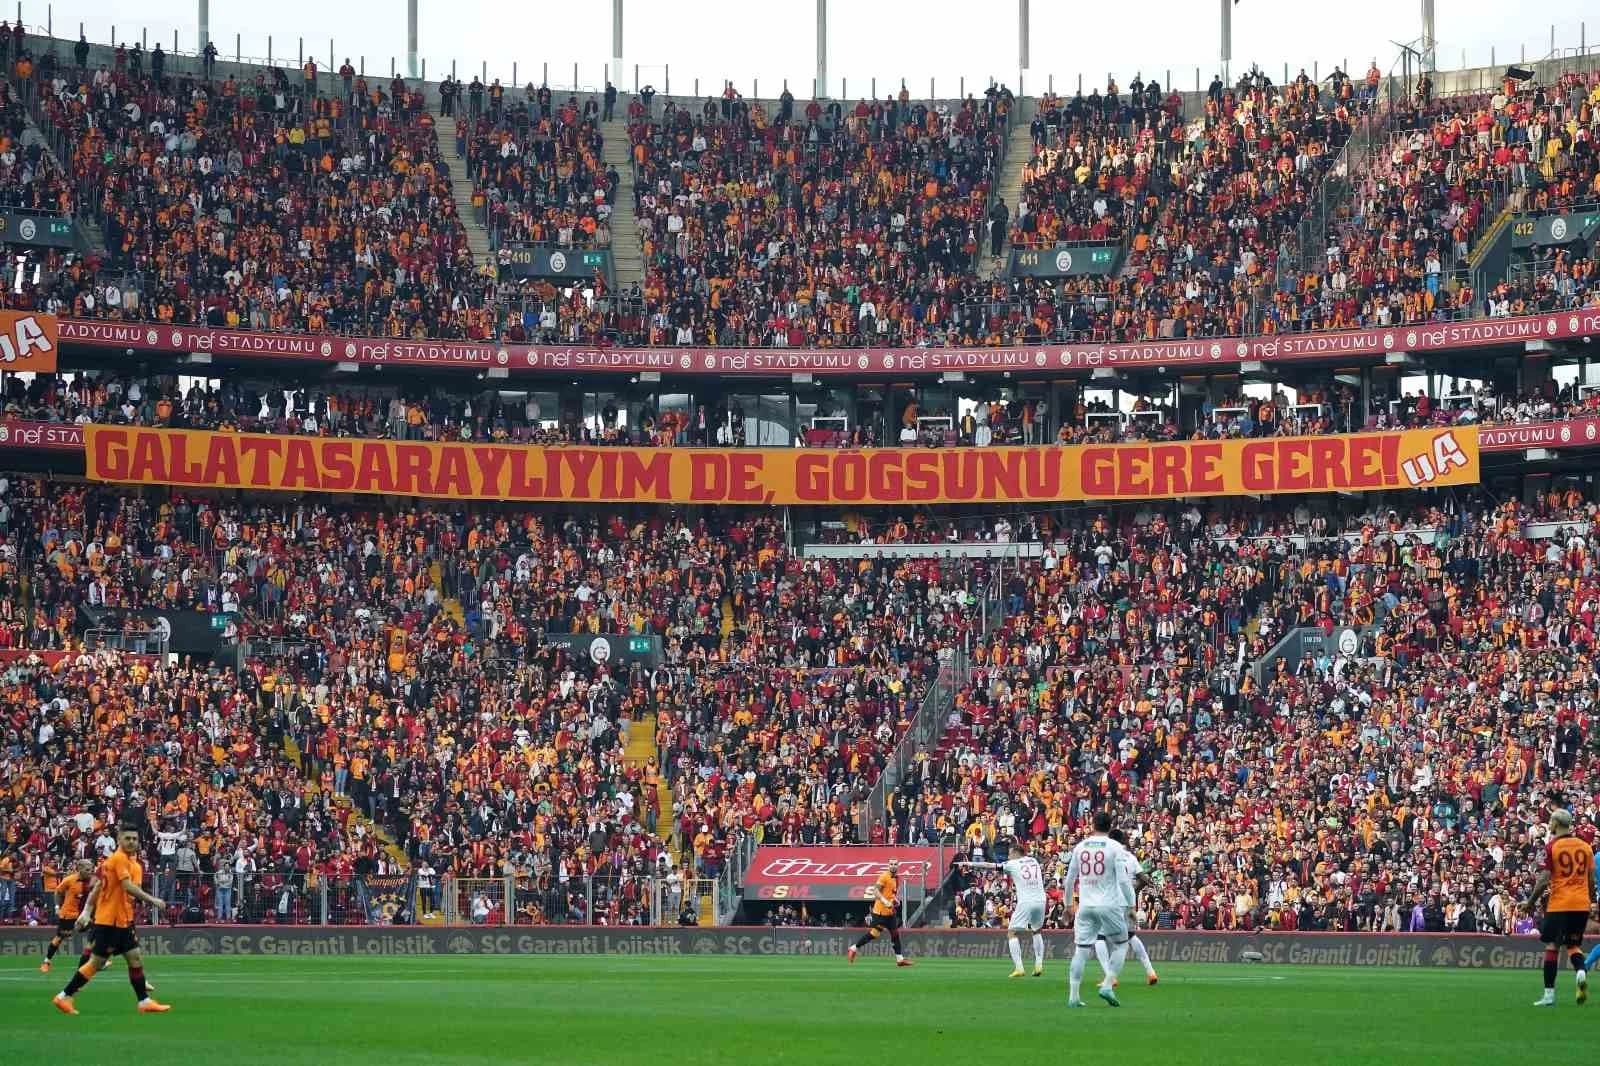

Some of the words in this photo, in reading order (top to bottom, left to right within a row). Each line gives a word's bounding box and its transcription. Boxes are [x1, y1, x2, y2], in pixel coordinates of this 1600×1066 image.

[1515, 222, 1533, 236] 412
[512, 251, 531, 263] 410
[1020, 252, 1038, 265] 411
[57, 323, 141, 341] TADYUMU
[1422, 326, 1449, 346] nef
[1451, 319, 1542, 341] STADYUMU
[1584, 314, 1600, 332] ne
[188, 326, 217, 349] nef
[219, 336, 314, 352] STADYUMU
[1254, 337, 1280, 357] nef
[1284, 334, 1377, 353] STADYUMU
[362, 342, 390, 360] nef
[393, 345, 491, 361] STADYUMU
[544, 348, 572, 367] nef
[576, 352, 673, 366] STADYUMU
[721, 349, 750, 369] nef
[753, 353, 851, 367] STADYUMU
[900, 351, 927, 368] nef
[932, 351, 1029, 367] STADYUMU
[1077, 347, 1105, 365] nef
[1109, 344, 1204, 361] STADYUMU
[15, 425, 43, 444] nef
[1478, 428, 1555, 446] TADYUMU
[95, 430, 672, 499] GALATASARAYLIYIM
[690, 452, 775, 505] DE,
[1081, 443, 1224, 495] GERE
[1241, 435, 1400, 492] GERE!
[1021, 863, 1039, 880] 37
[1081, 850, 1105, 876] 88
[1558, 849, 1587, 878] 99
[758, 885, 811, 899] GSM
[848, 885, 877, 899] GS
[220, 936, 251, 954] SC
[259, 935, 346, 955] Garanti
[481, 935, 511, 954] SC
[518, 935, 598, 955] Garanti
[724, 936, 751, 954] SC
[758, 936, 843, 956] Garanti
[925, 938, 944, 957] SC
[951, 938, 1002, 958] Garanti
[1171, 940, 1230, 962] Lojistik
[1262, 941, 1285, 963] SC
[1289, 942, 1351, 964] Garanti
[1355, 943, 1421, 965] Lojistik
[1458, 945, 1486, 967] SC
